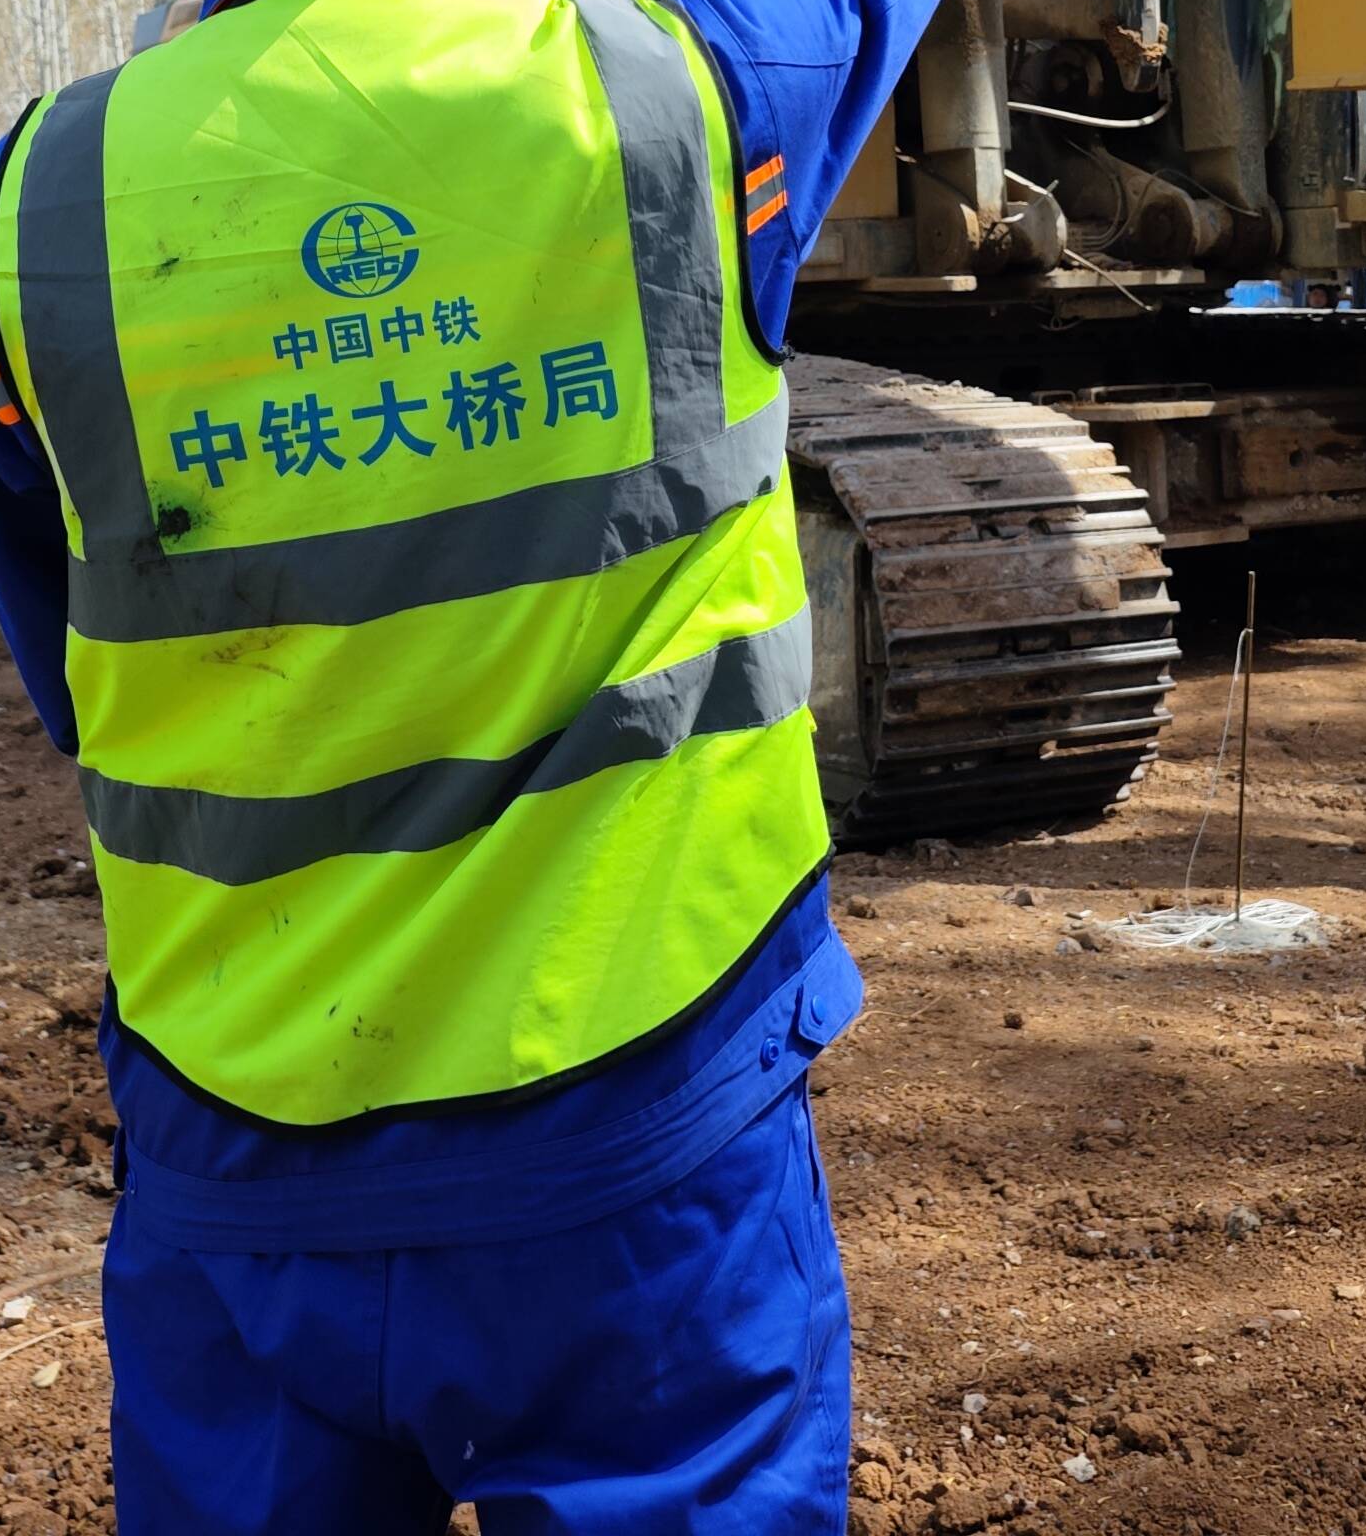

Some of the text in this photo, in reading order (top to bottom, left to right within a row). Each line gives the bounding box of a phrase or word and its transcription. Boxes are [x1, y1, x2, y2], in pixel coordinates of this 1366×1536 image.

[272, 296, 482, 370] 中国中铁
[169, 341, 619, 489] 中铁大桥局
